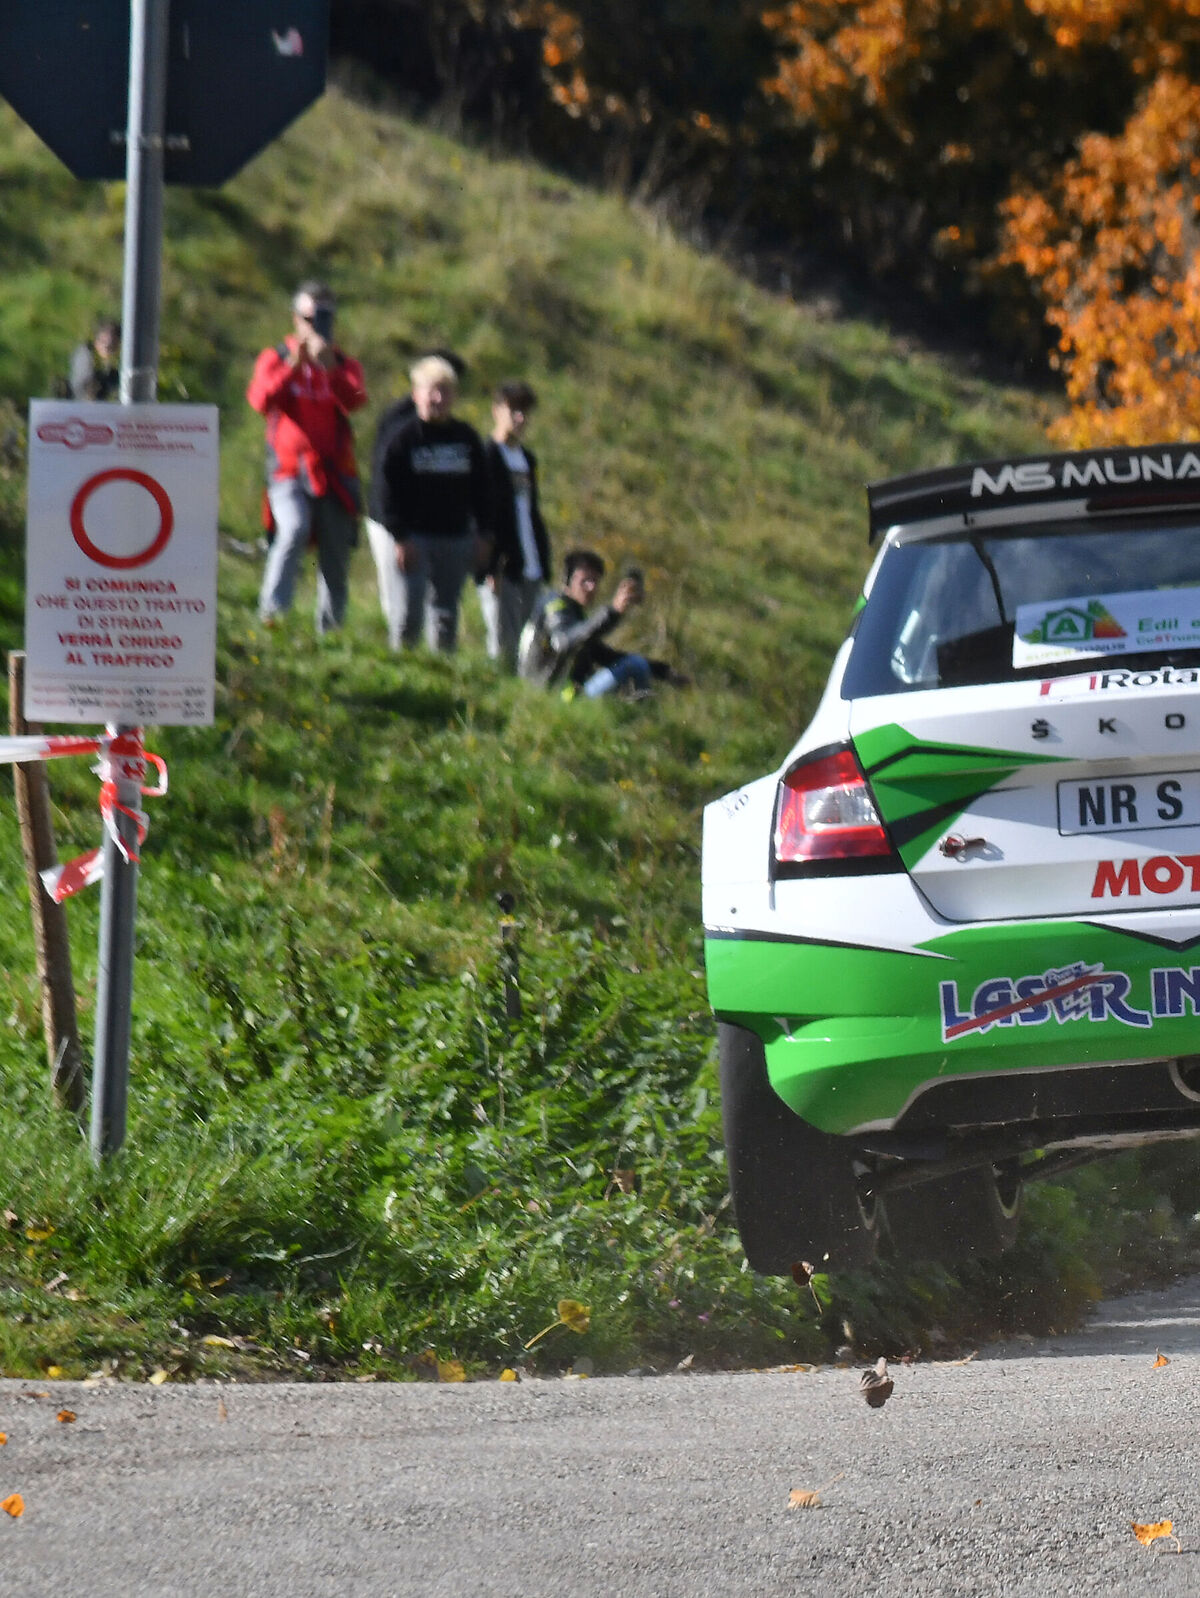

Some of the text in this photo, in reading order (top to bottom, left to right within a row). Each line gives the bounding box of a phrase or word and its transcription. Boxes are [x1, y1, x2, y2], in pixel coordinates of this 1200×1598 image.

[971, 462, 1055, 497] MS
[64, 577, 177, 594] SI COMUNICA
[35, 594, 206, 614] CHE QUESTO TRATTO
[77, 614, 164, 631] DI STRADA
[1137, 617, 1180, 632] Edil
[56, 630, 183, 650] VERRÀ CHIUSO
[65, 651, 175, 668] AL TRAFFICO
[1078, 784, 1138, 826] NR
[1157, 780, 1183, 821] S
[940, 964, 1152, 1043] LASER
